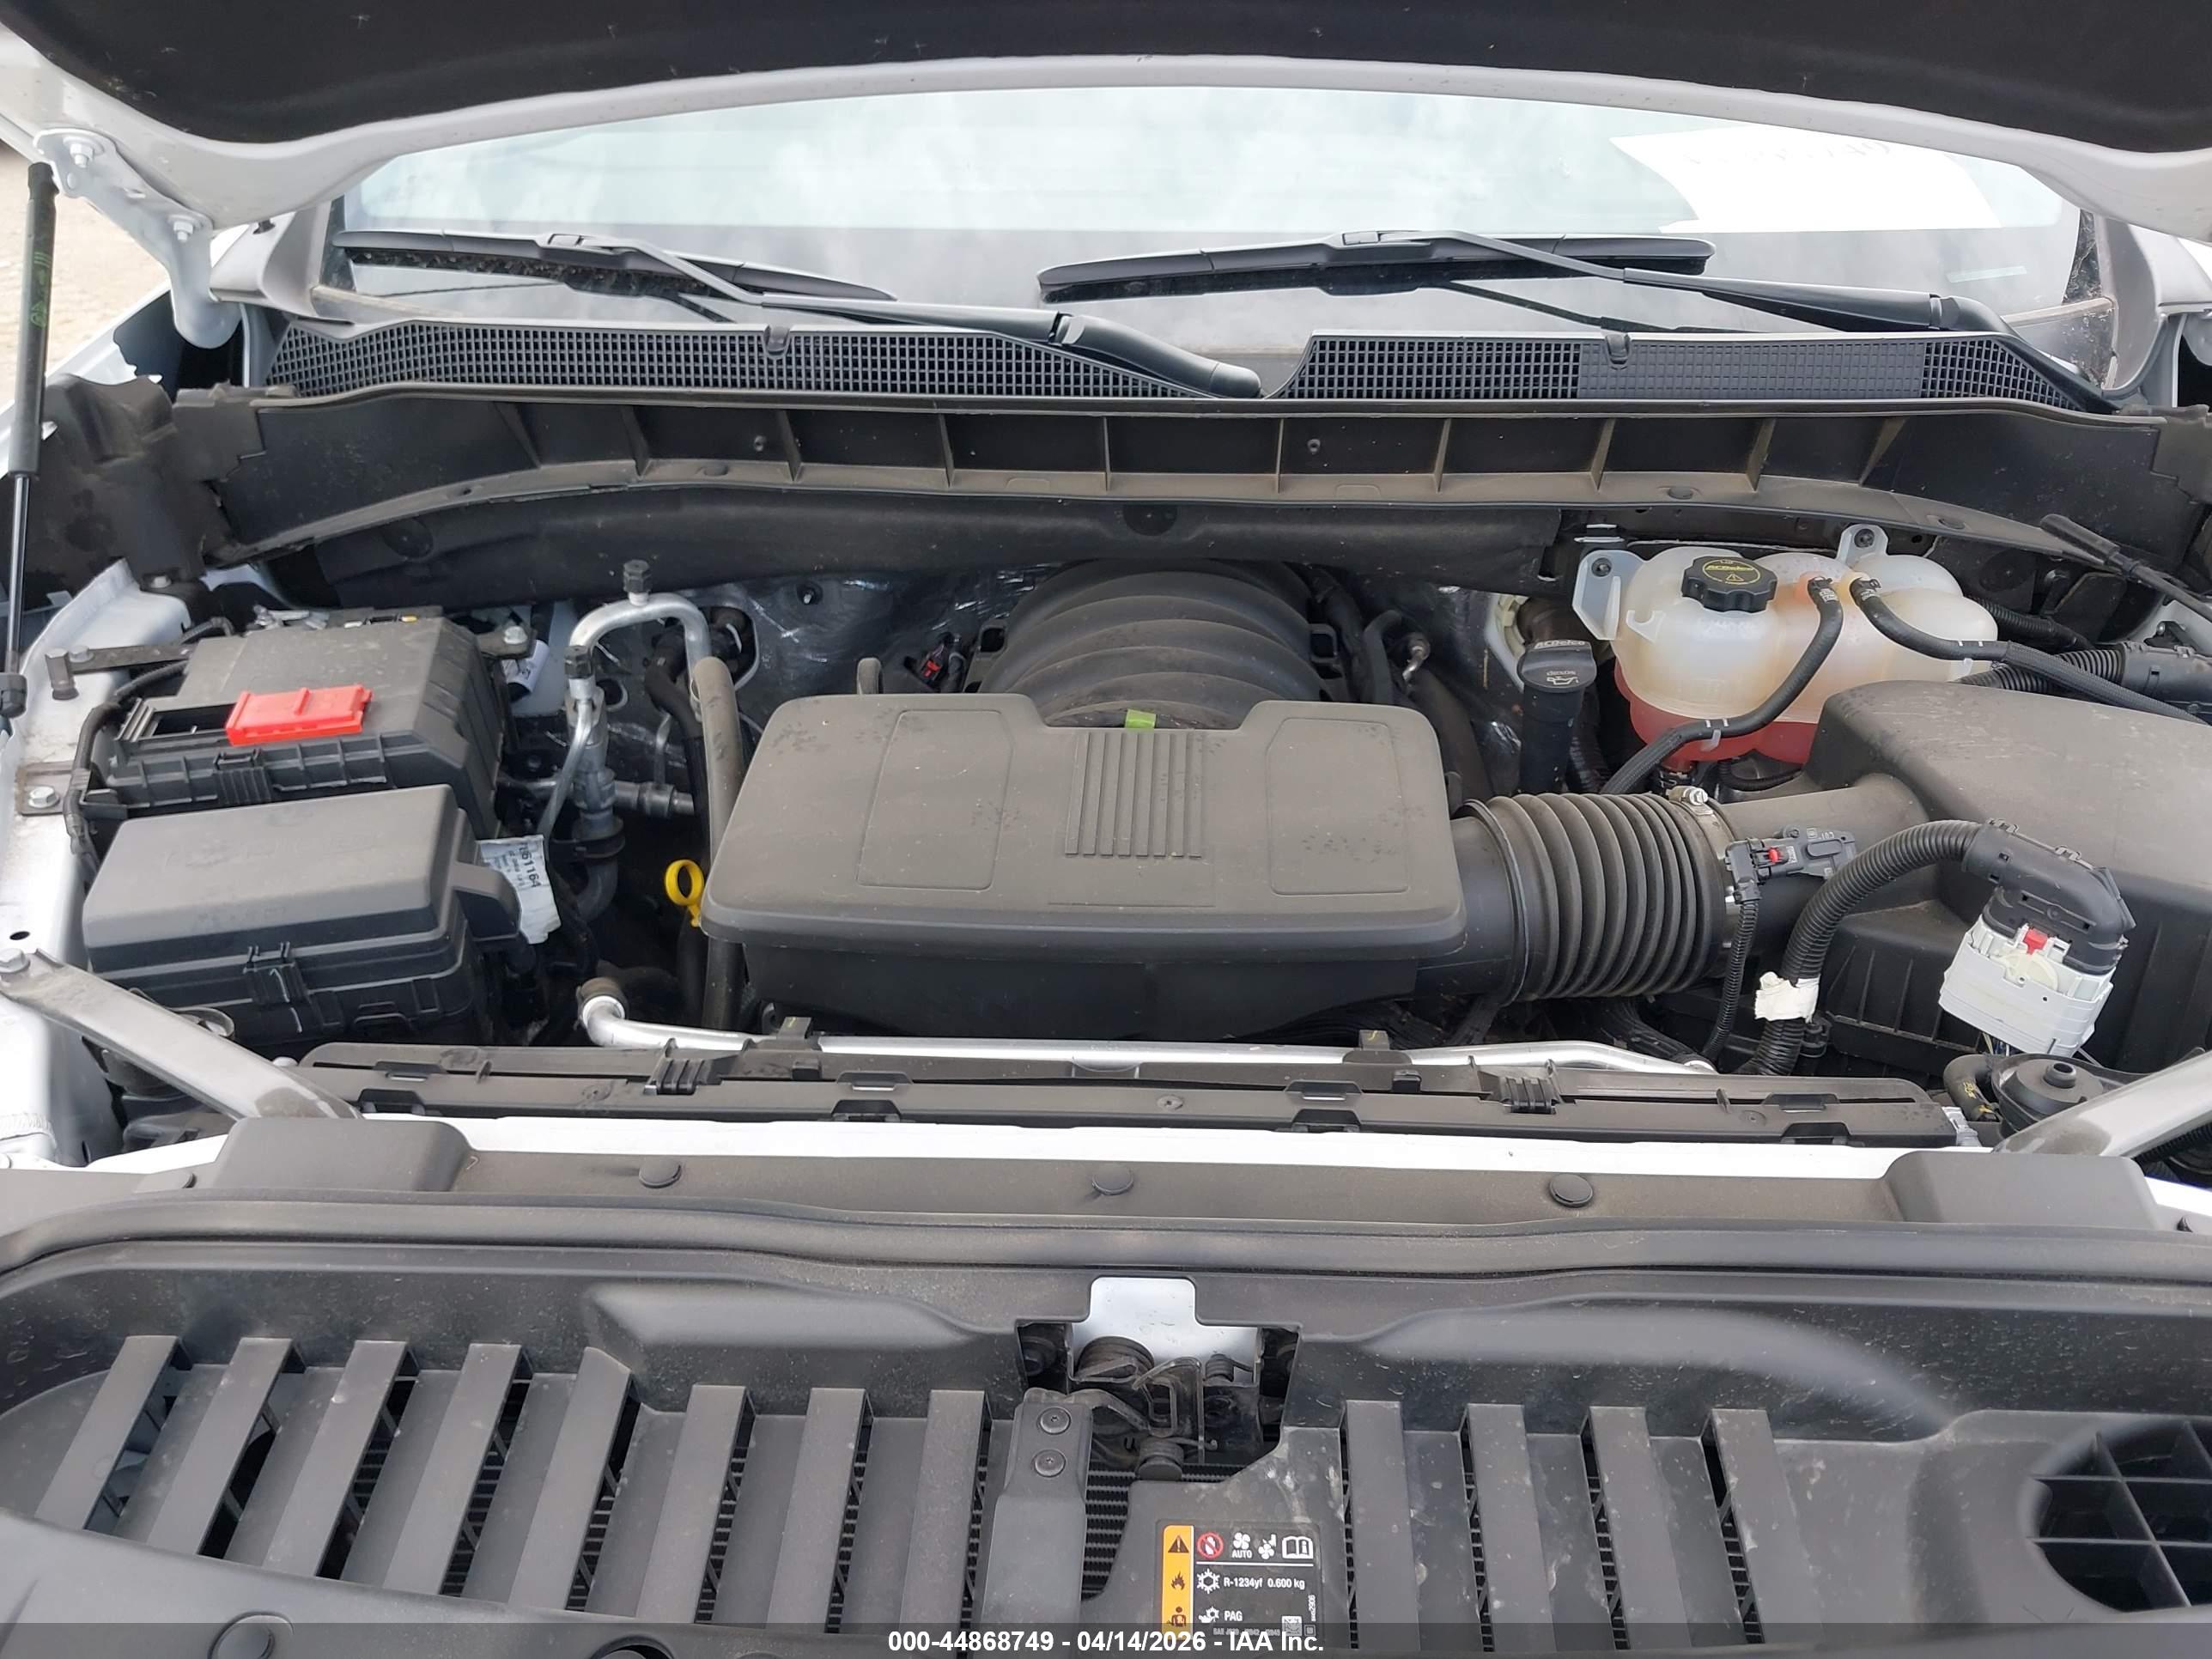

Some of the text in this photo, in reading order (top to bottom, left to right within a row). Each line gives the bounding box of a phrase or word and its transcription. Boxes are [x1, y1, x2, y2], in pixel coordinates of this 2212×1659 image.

[1231, 1549, 1253, 1559] AUTO
[1223, 1577, 1305, 1590] R-1234yf 0.600 kg
[1224, 1610, 1243, 1622] PAG
